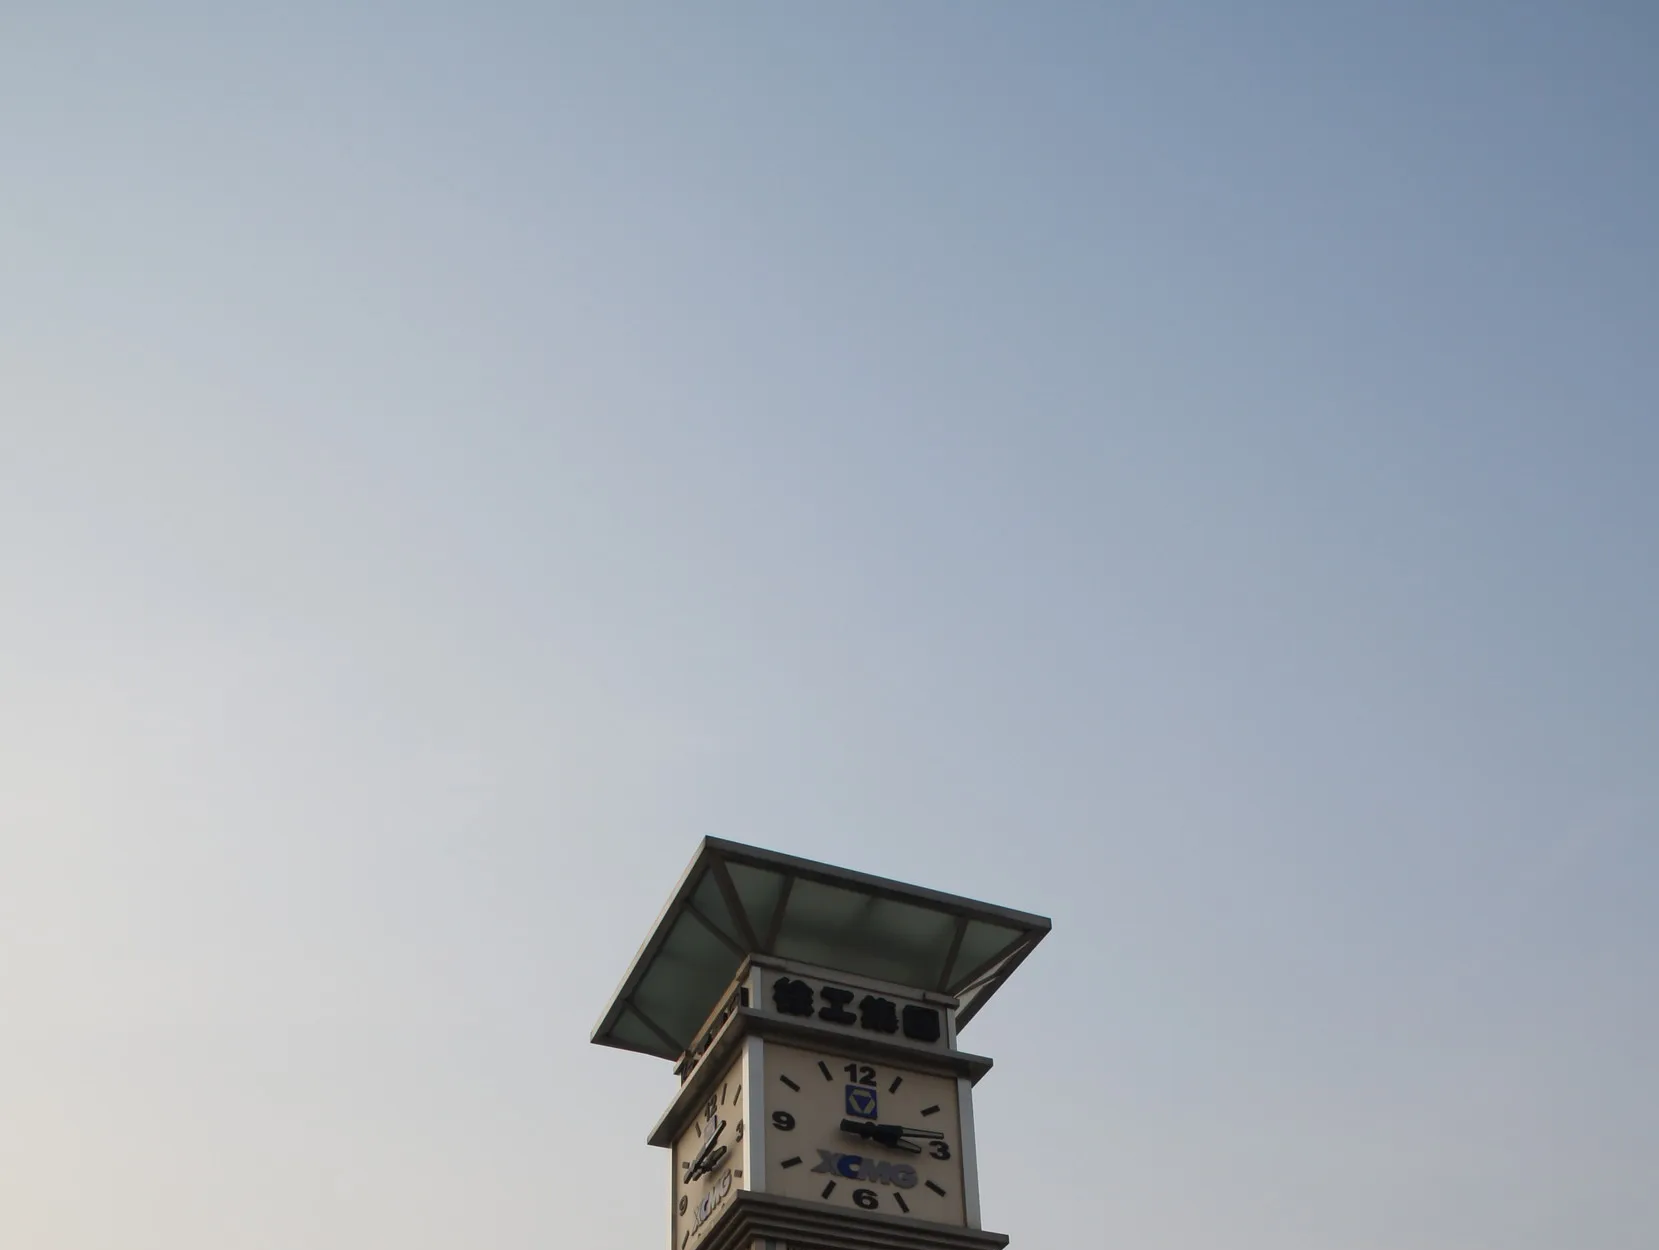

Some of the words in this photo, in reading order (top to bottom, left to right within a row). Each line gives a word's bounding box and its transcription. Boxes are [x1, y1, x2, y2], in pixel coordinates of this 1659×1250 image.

[844, 1063, 877, 1087] 12
[771, 1110, 796, 1131] 9
[928, 1140, 951, 1161] 3
[811, 1149, 918, 1189] XCMG
[853, 1188, 879, 1209] 6
